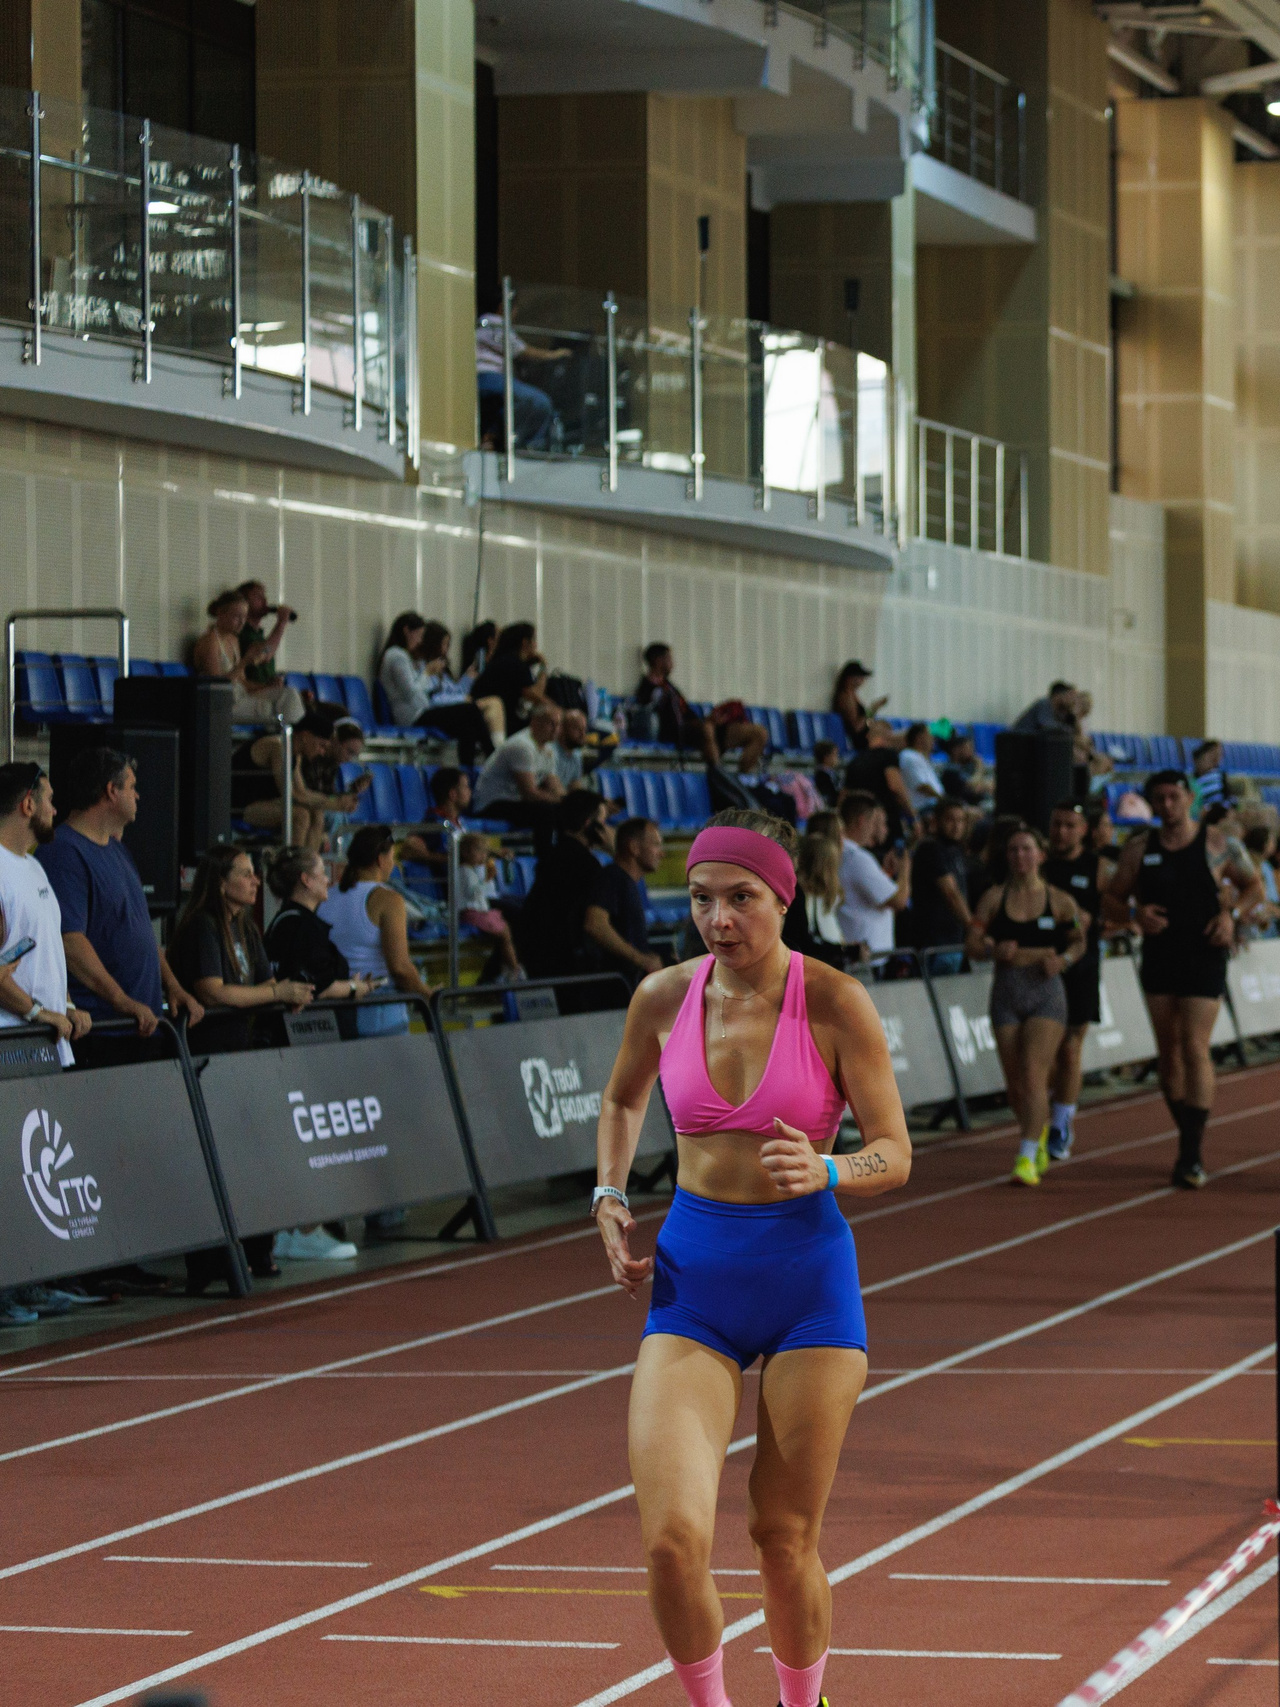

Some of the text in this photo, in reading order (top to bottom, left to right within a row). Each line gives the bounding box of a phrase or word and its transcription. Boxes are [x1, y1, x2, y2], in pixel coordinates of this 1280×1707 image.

[551, 1059, 581, 1093] ТВОЙ
[288, 1091, 382, 1143] СЕВЕР
[846, 1152, 888, 1180] 15303
[58, 1174, 102, 1216] ГТС
